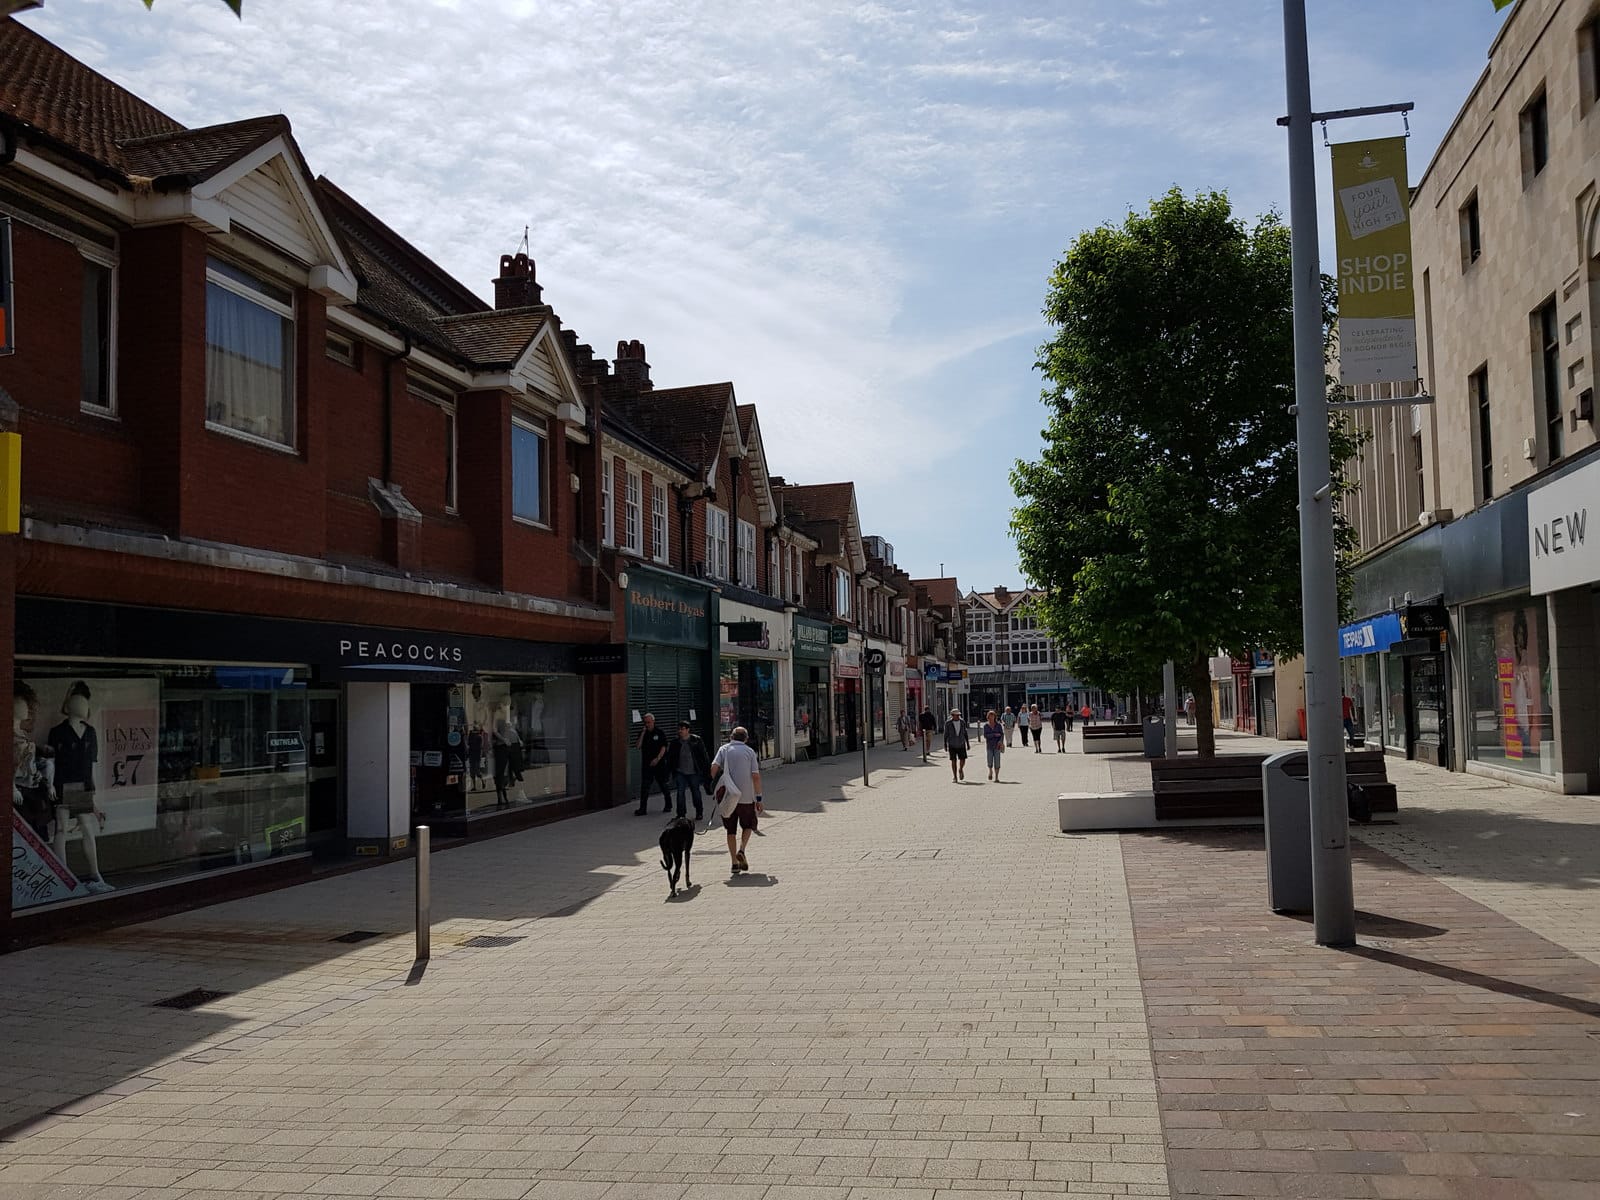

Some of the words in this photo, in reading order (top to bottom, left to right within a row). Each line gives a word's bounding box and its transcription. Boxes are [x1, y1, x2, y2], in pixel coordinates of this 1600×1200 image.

[1341, 253, 1407, 276] SHOP
[1341, 272, 1406, 295] INDIE
[1351, 326, 1404, 337] CELEBRATING
[1389, 341, 1412, 350] REGIS
[1534, 508, 1587, 559] NEW
[631, 591, 676, 612] Robert
[678, 601, 705, 618] Dyas
[340, 640, 462, 662] PEACOCKS
[868, 653, 882, 664] JD
[105, 727, 153, 743] LINEN
[111, 754, 145, 788] £7
